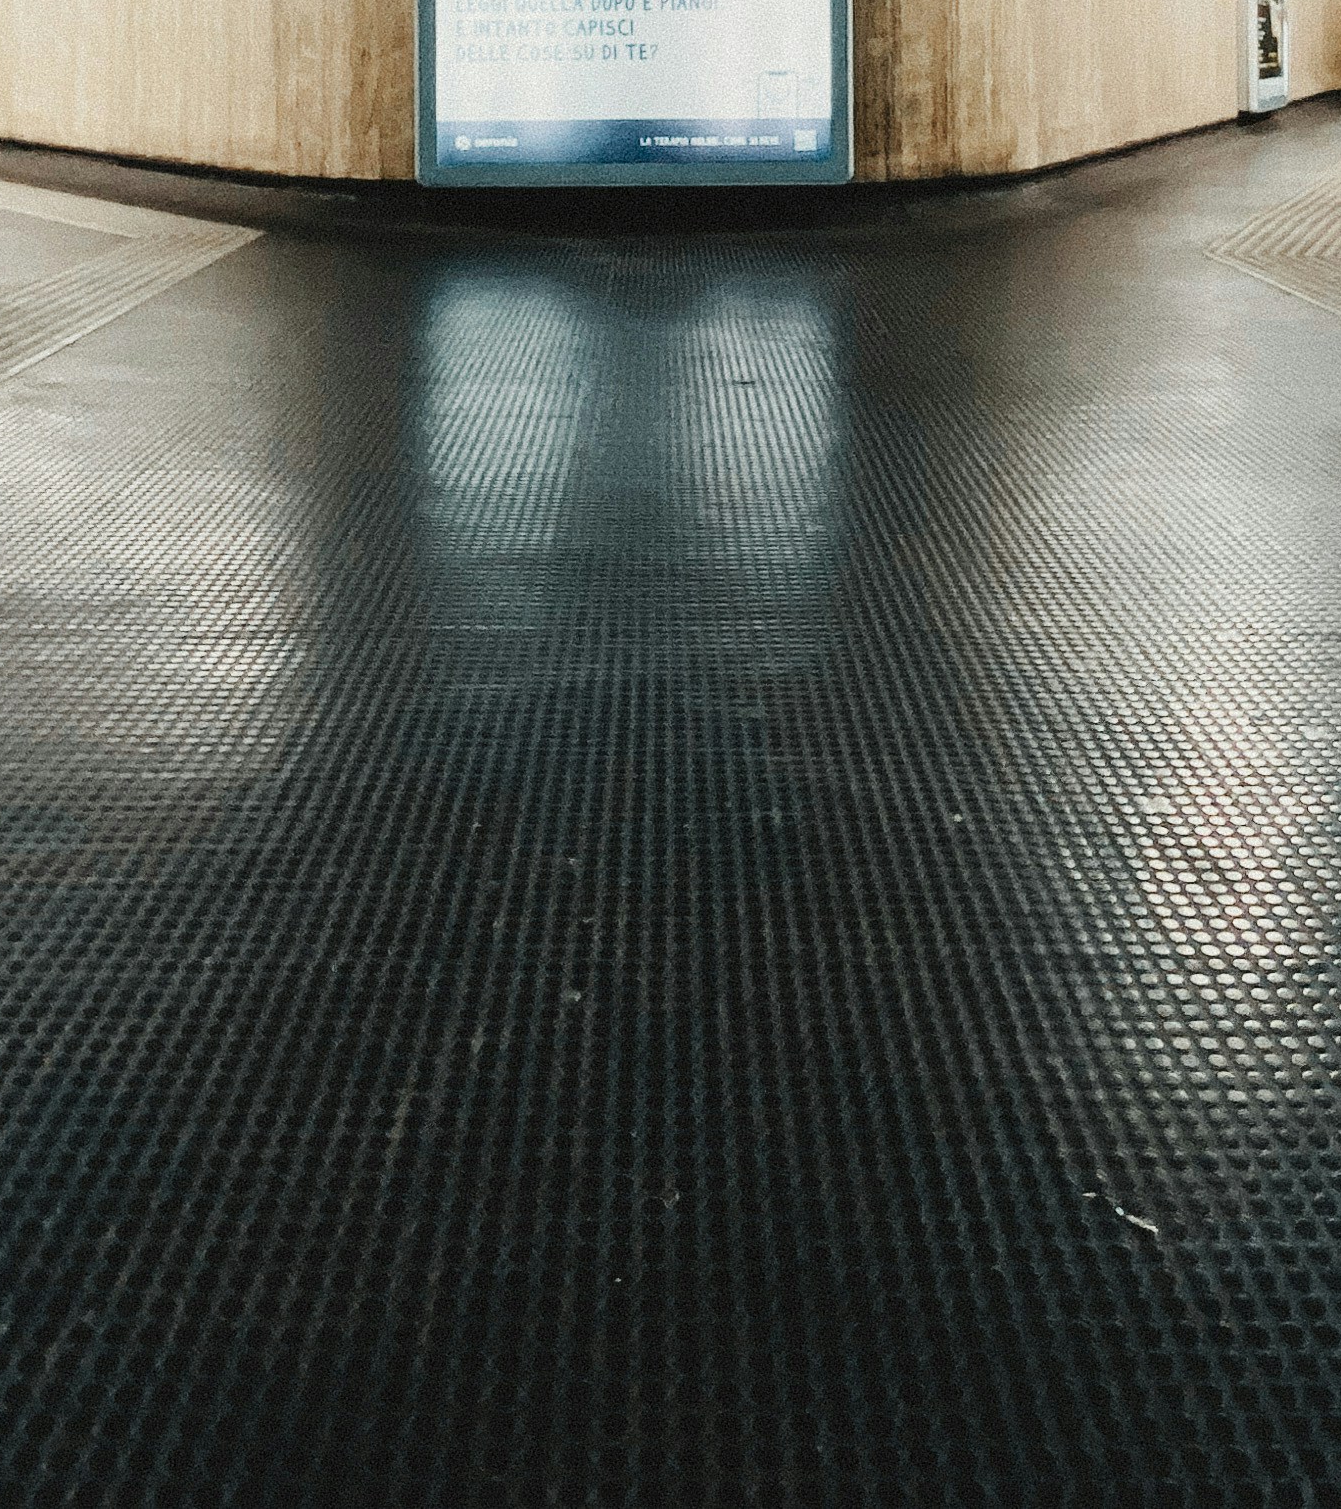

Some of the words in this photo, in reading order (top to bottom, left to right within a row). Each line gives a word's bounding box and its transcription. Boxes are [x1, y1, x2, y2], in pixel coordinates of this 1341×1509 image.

[564, 18, 634, 37] CAPISCI
[601, 43, 618, 61] DI
[625, 43, 659, 61] TE?
